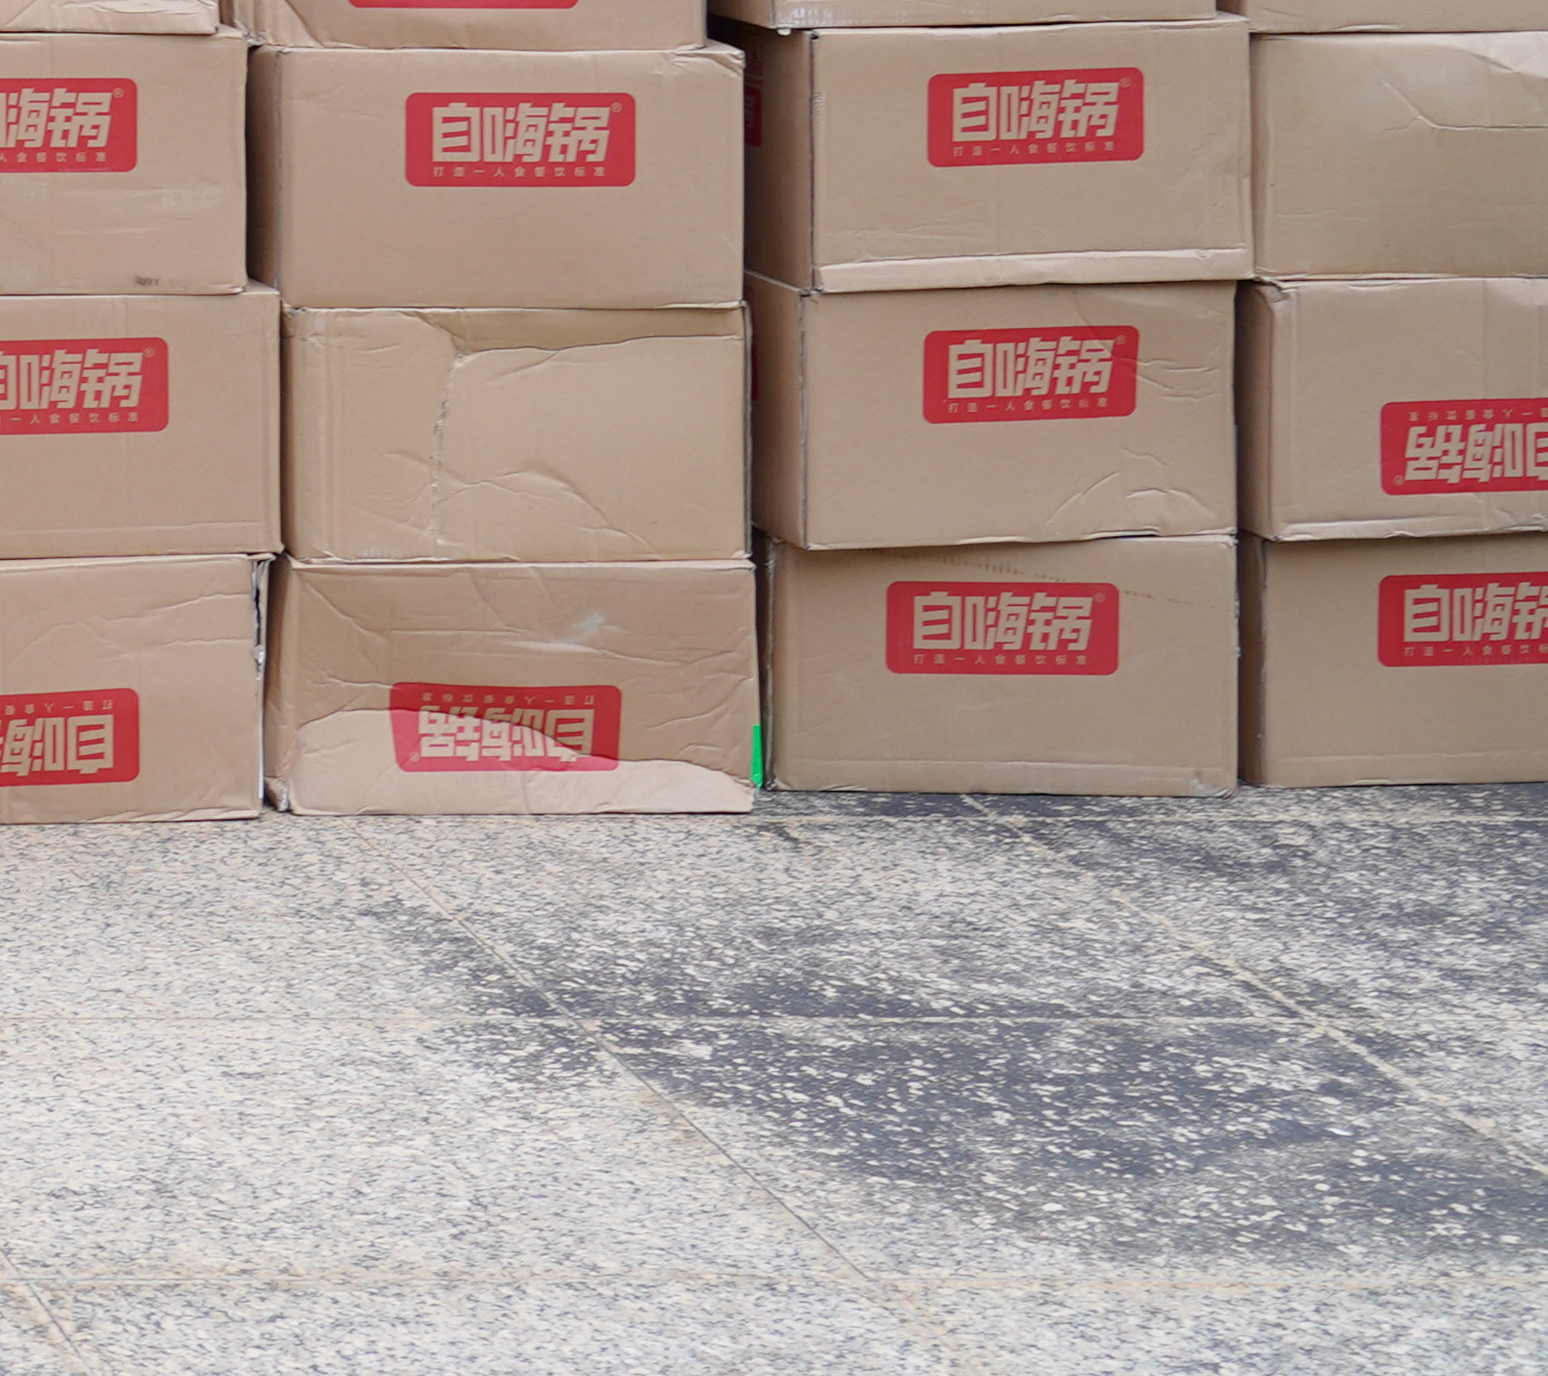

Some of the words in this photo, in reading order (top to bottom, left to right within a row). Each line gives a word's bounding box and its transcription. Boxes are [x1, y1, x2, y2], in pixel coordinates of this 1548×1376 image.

[432, 102, 612, 163] 自嗨锅
[952, 81, 1120, 141] 自嗨锅
[946, 336, 1114, 398] 自嗨锅
[912, 591, 1092, 652] 自嗨锅
[418, 705, 596, 762] 自嗨锅
